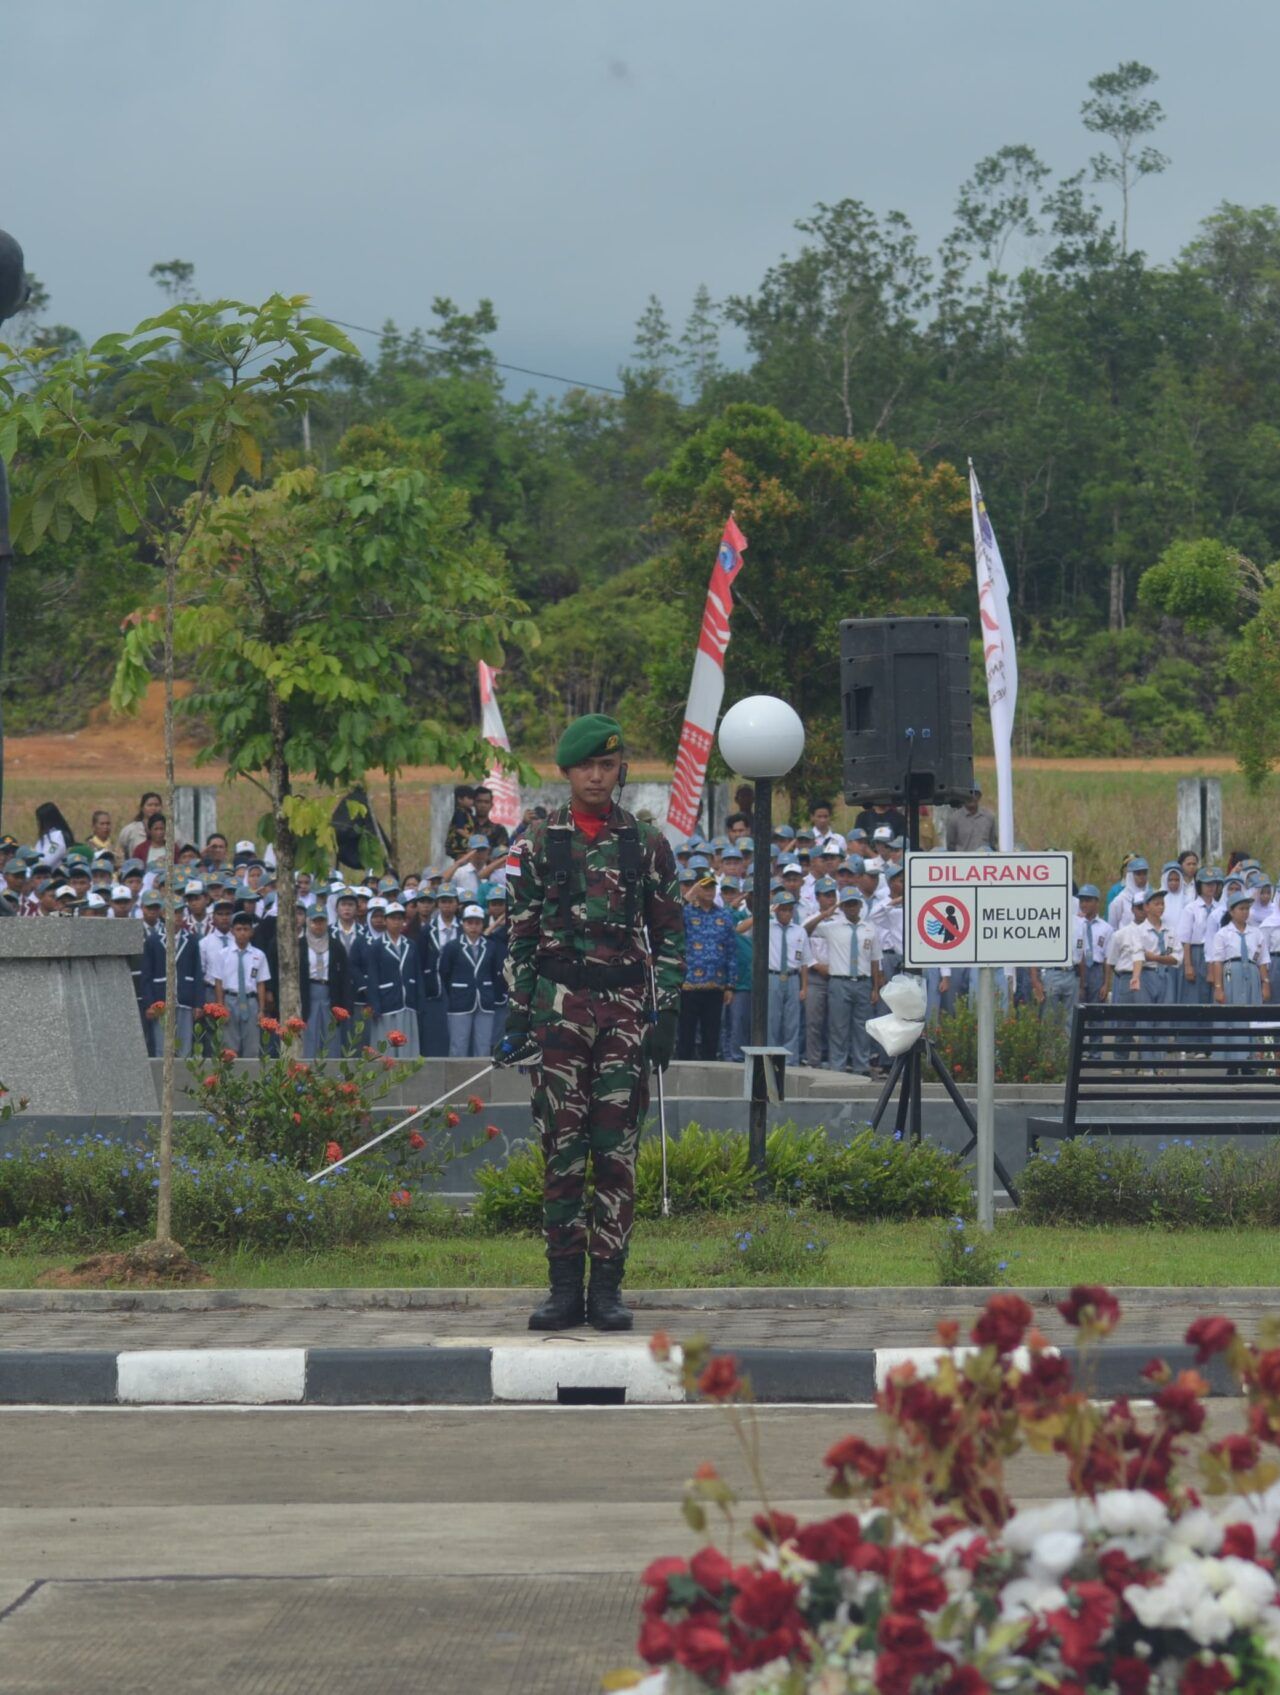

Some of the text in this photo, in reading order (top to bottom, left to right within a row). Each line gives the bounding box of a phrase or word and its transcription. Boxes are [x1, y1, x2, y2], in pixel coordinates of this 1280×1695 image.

[928, 864, 1050, 882] DILARANG
[982, 907, 1061, 921] MELUDAH
[983, 926, 1061, 939] DI KOLAM
